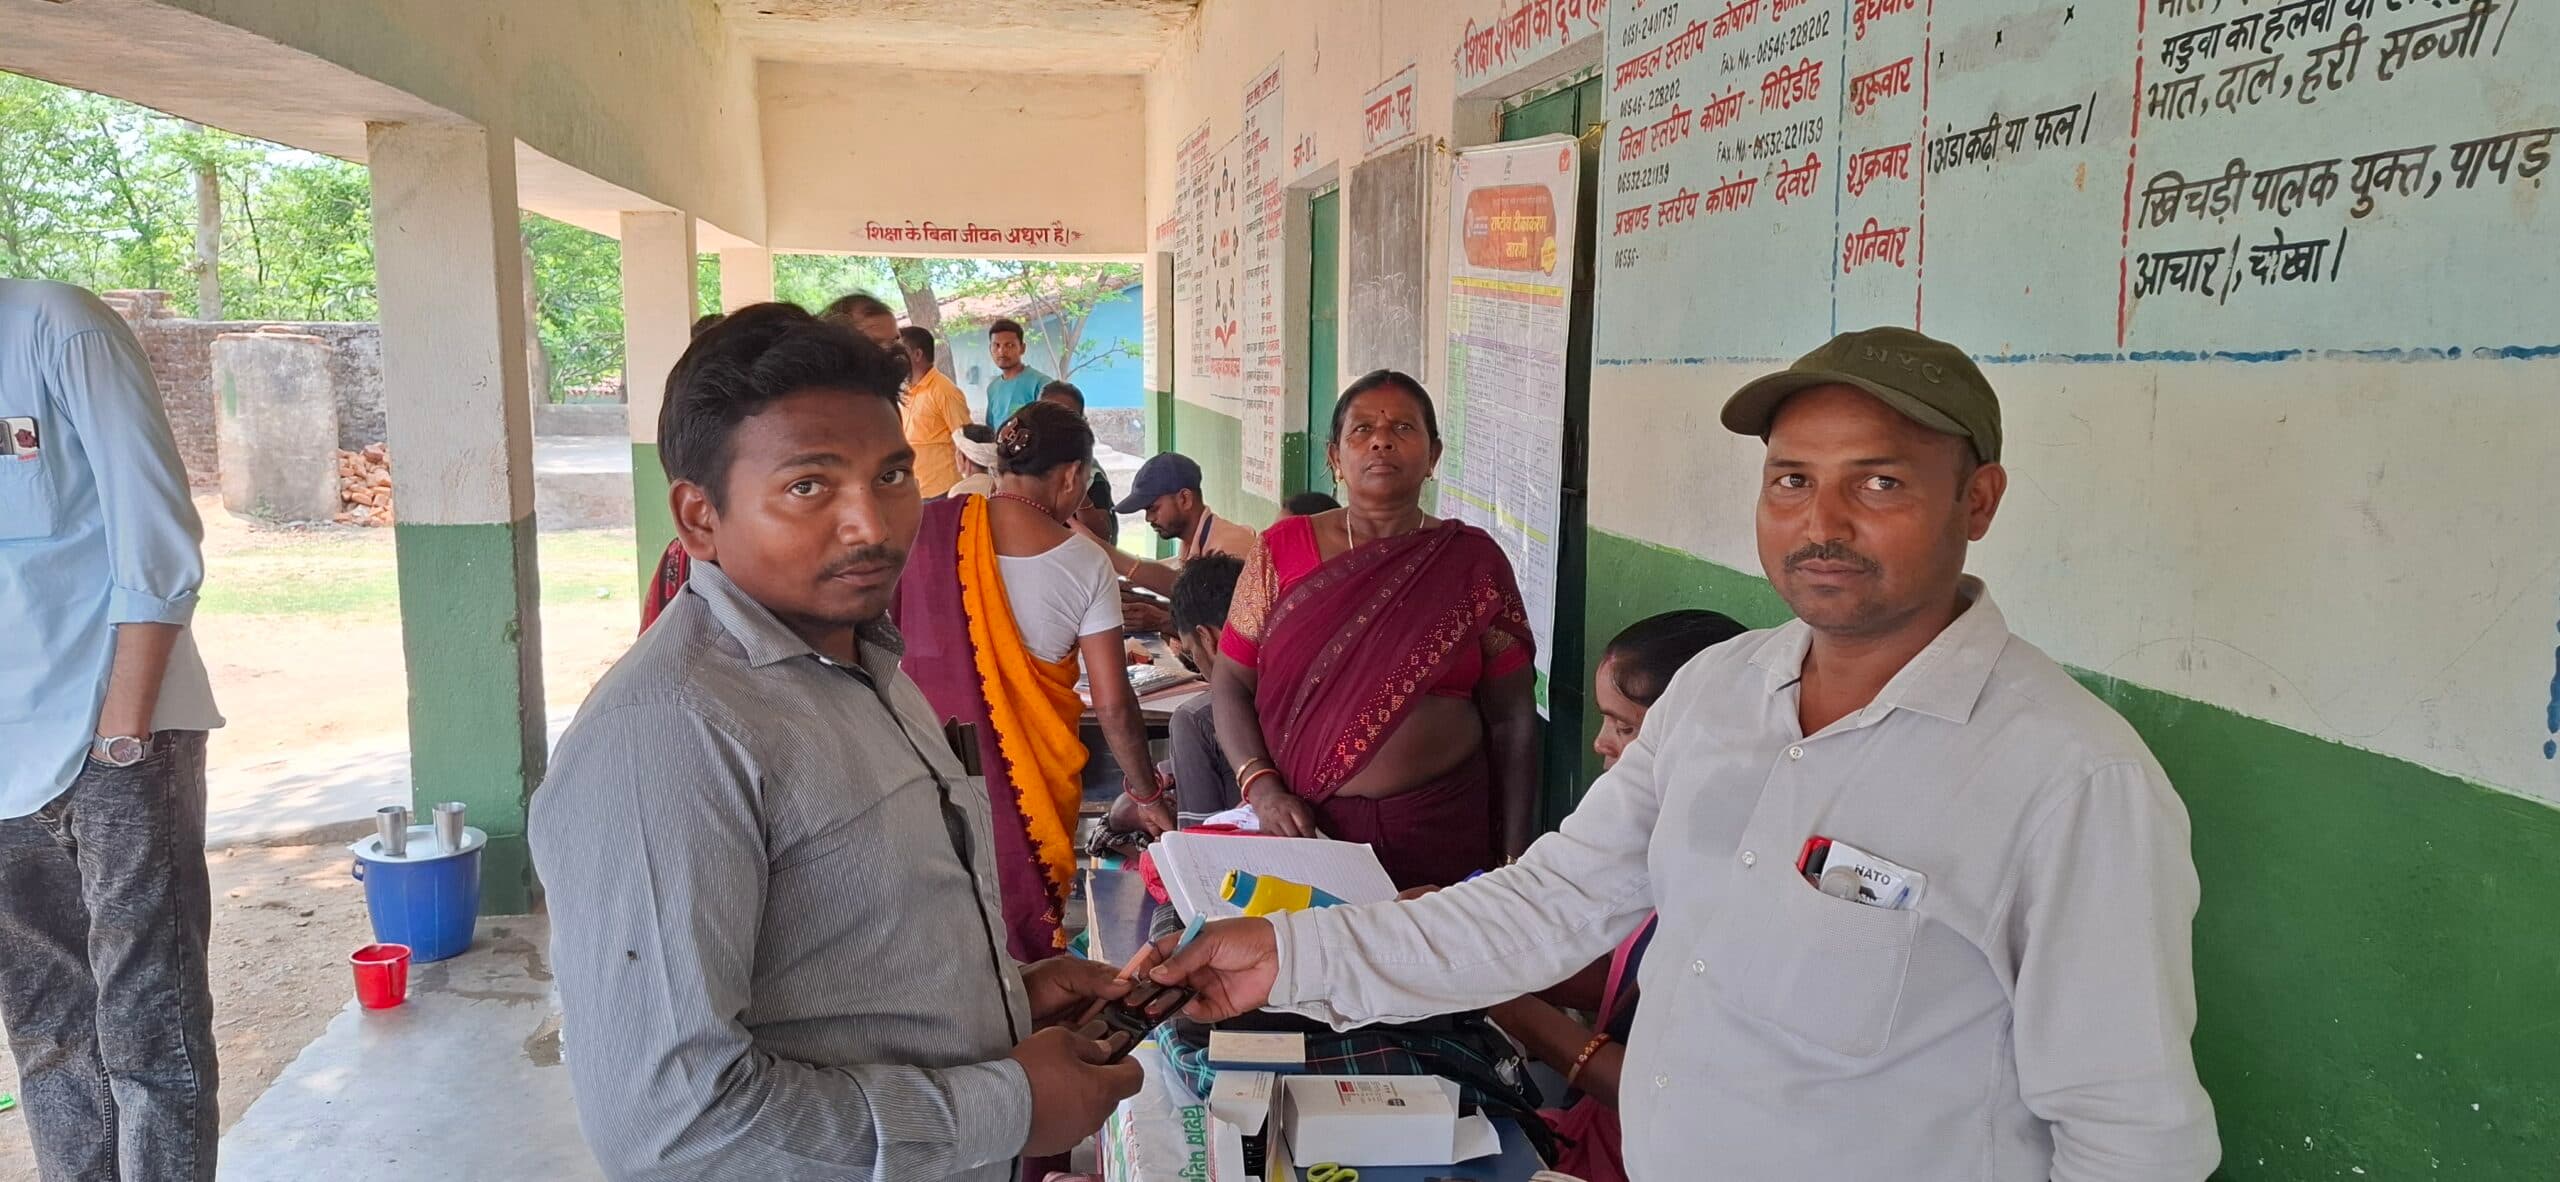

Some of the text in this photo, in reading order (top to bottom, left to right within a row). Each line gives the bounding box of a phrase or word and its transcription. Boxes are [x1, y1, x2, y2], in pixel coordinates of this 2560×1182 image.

[1464, 17, 1495, 78] शिक्षा
[1666, 19, 1707, 70] स्तरीय
[2226, 12, 2263, 51] का
[2298, 22, 2369, 104] हरी
[1618, 125, 1648, 163] जिला
[1651, 103, 1693, 152] स्तरीय
[1700, 84, 1745, 132] कोषांग
[1760, 57, 1824, 115] गिरिडीह
[2005, 117, 2030, 154] या
[1613, 152, 1822, 237] प्रखण्ड स्तरीय कोषांग देवरी
[1847, 142, 1912, 197] शुक्रवार
[2138, 157, 2252, 230] खिचड़ी
[2252, 159, 2343, 217] पालक
[2448, 127, 2560, 192] पापड़
[865, 221, 902, 242] शिक्षा
[905, 219, 921, 241] के
[923, 221, 959, 242] बिना
[961, 222, 1002, 243] जीवन
[1005, 226, 1050, 247] अधूरा
[1843, 217, 1911, 274] शनिवार
[1854, 864, 1891, 886] NATO
